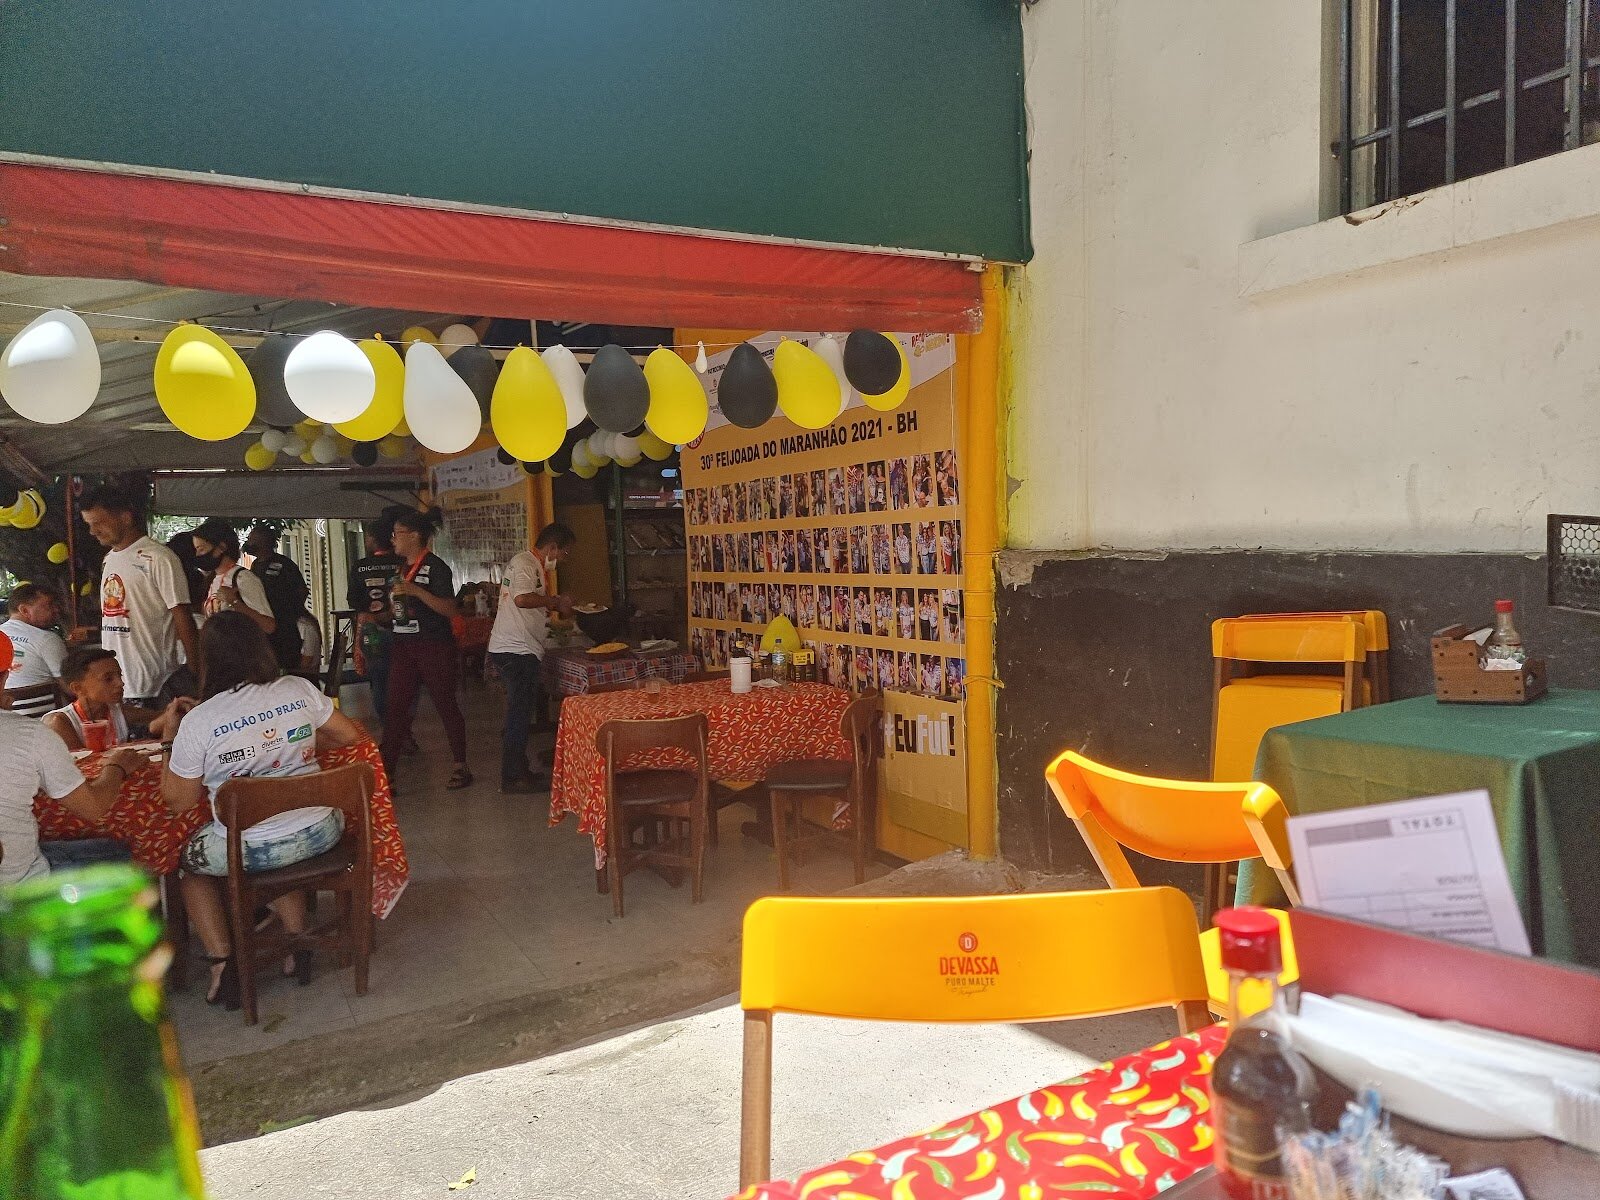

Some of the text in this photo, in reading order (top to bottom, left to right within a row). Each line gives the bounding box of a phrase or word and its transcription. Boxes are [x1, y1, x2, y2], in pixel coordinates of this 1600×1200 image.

[716, 444, 760, 468] FEIJOADA
[763, 440, 777, 458] DO
[780, 423, 847, 456] MARANHÃO
[851, 417, 882, 442] 2021
[897, 410, 918, 434] BH
[213, 699, 308, 738] EDIÇÃO DO BRASIL
[1402, 815, 1454, 831] TOTAL
[940, 956, 1000, 975] DEVASSA
[945, 977, 996, 986] PURO MALTE
